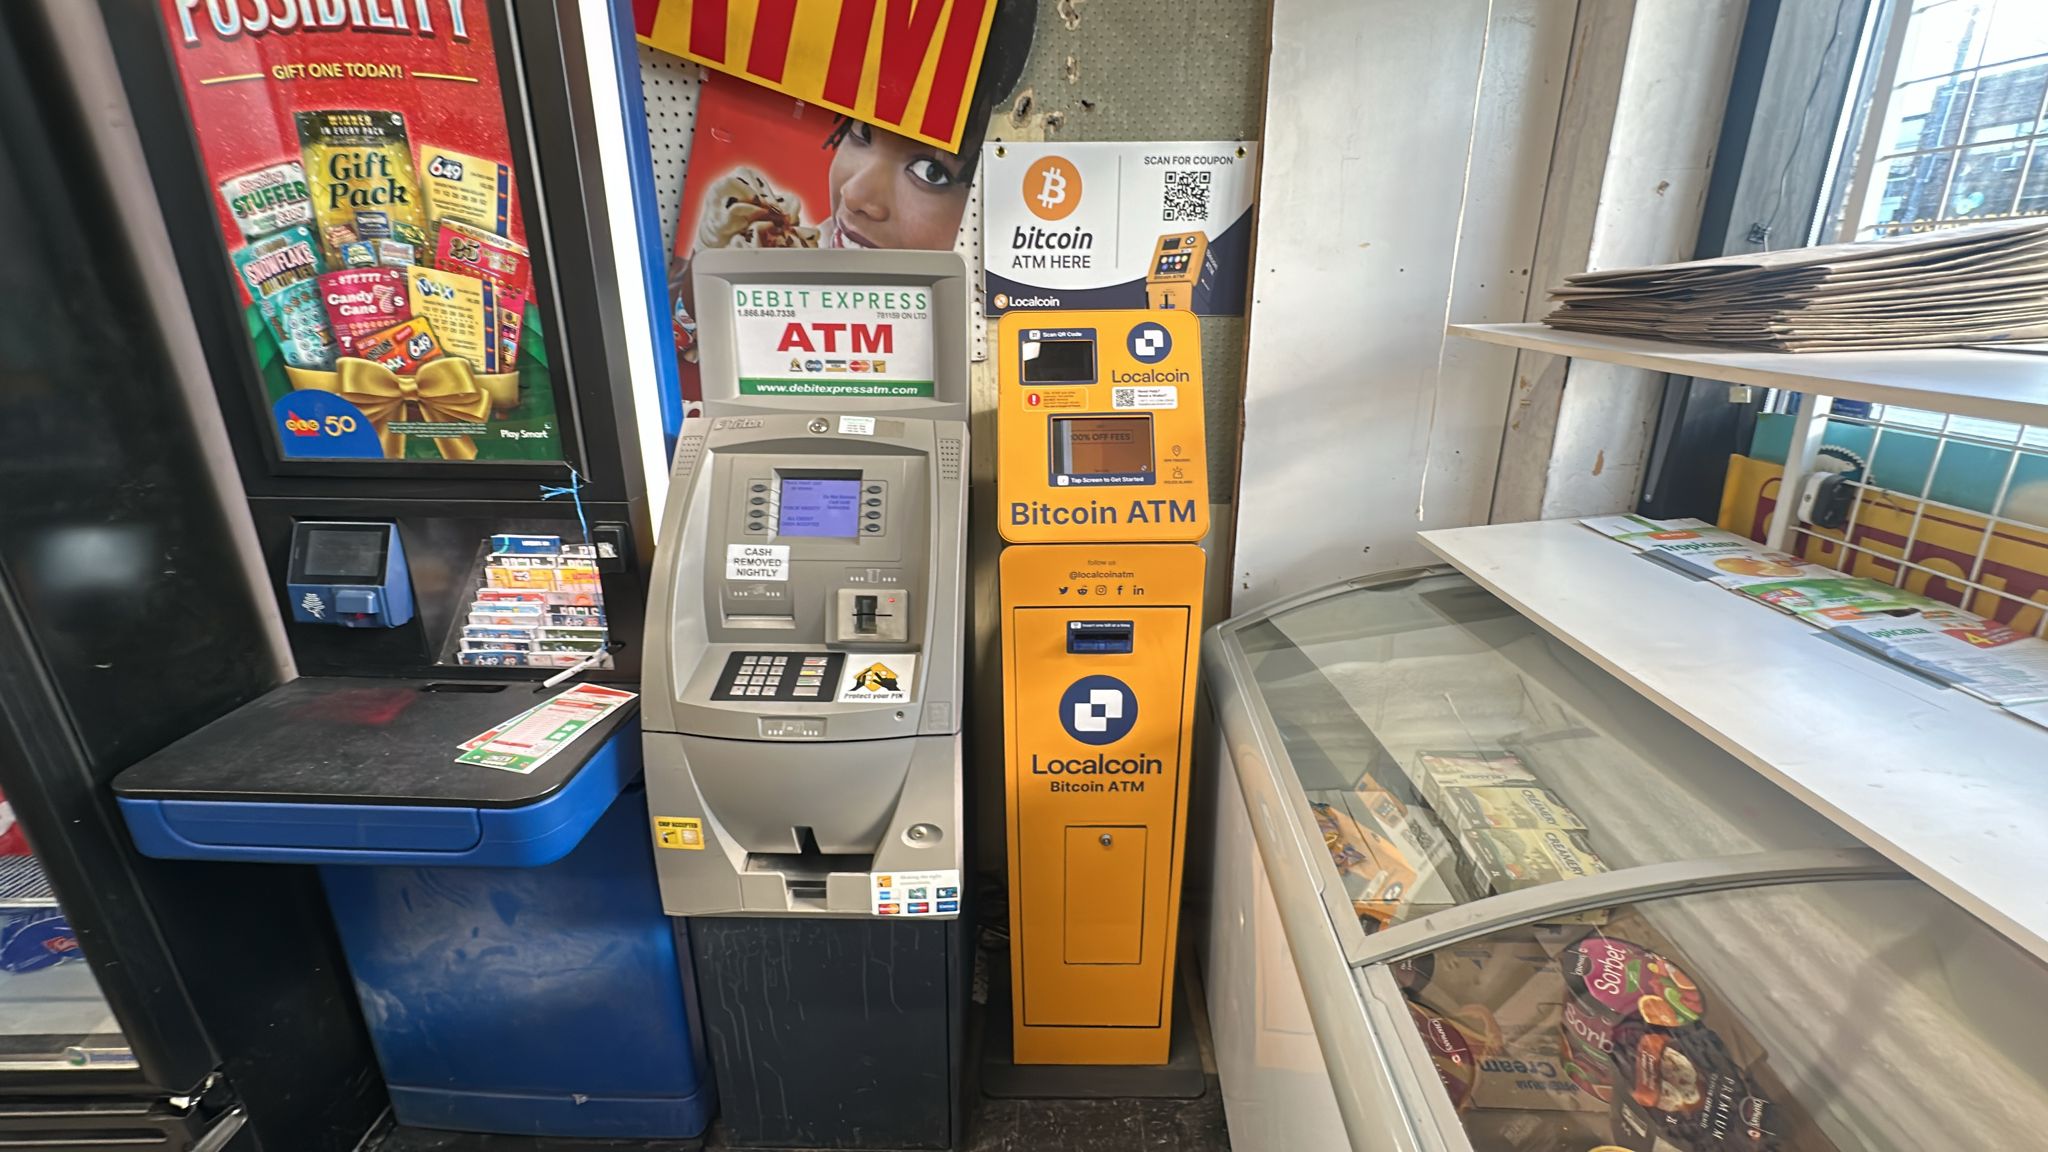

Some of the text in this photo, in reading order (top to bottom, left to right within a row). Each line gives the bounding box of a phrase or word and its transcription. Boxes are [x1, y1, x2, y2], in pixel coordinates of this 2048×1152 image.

[272, 61, 403, 79] GIFT ONE TODAY!
[329, 152, 392, 181] Gift
[1144, 156, 1234, 165] SCAN FOR COUPON
[231, 181, 311, 216] STUFFER
[329, 178, 409, 211] Pack
[1012, 226, 1093, 250] bitcoin
[1012, 255, 1091, 269] ATM HERE
[327, 291, 374, 306] Candy
[736, 290, 927, 310] DEBIT EXPRESS
[1009, 295, 1060, 307] Localcoin
[339, 304, 378, 317] Cane
[913, 312, 927, 320] LTD
[776, 322, 894, 354] ATM
[1111, 369, 1190, 384] Localcoin
[756, 383, 919, 396] www.debitexpressatm.com
[324, 416, 357, 436] 50
[500, 429, 549, 440] Play Smart
[1011, 499, 1196, 526] Bitcoin ATM
[744, 548, 773, 557] CASH
[733, 557, 782, 567] REMOVED
[736, 568, 779, 578] NIGHTLY
[1069, 570, 1134, 580] @localcoinatm
[1032, 753, 1163, 775] Localcoin
[1050, 781, 1145, 793] Bitcoin ATM
[1594, 943, 1627, 995] Sorbet
[1479, 1058, 1557, 1078] Cream
[1711, 1074, 1736, 1140] PREMIUM
